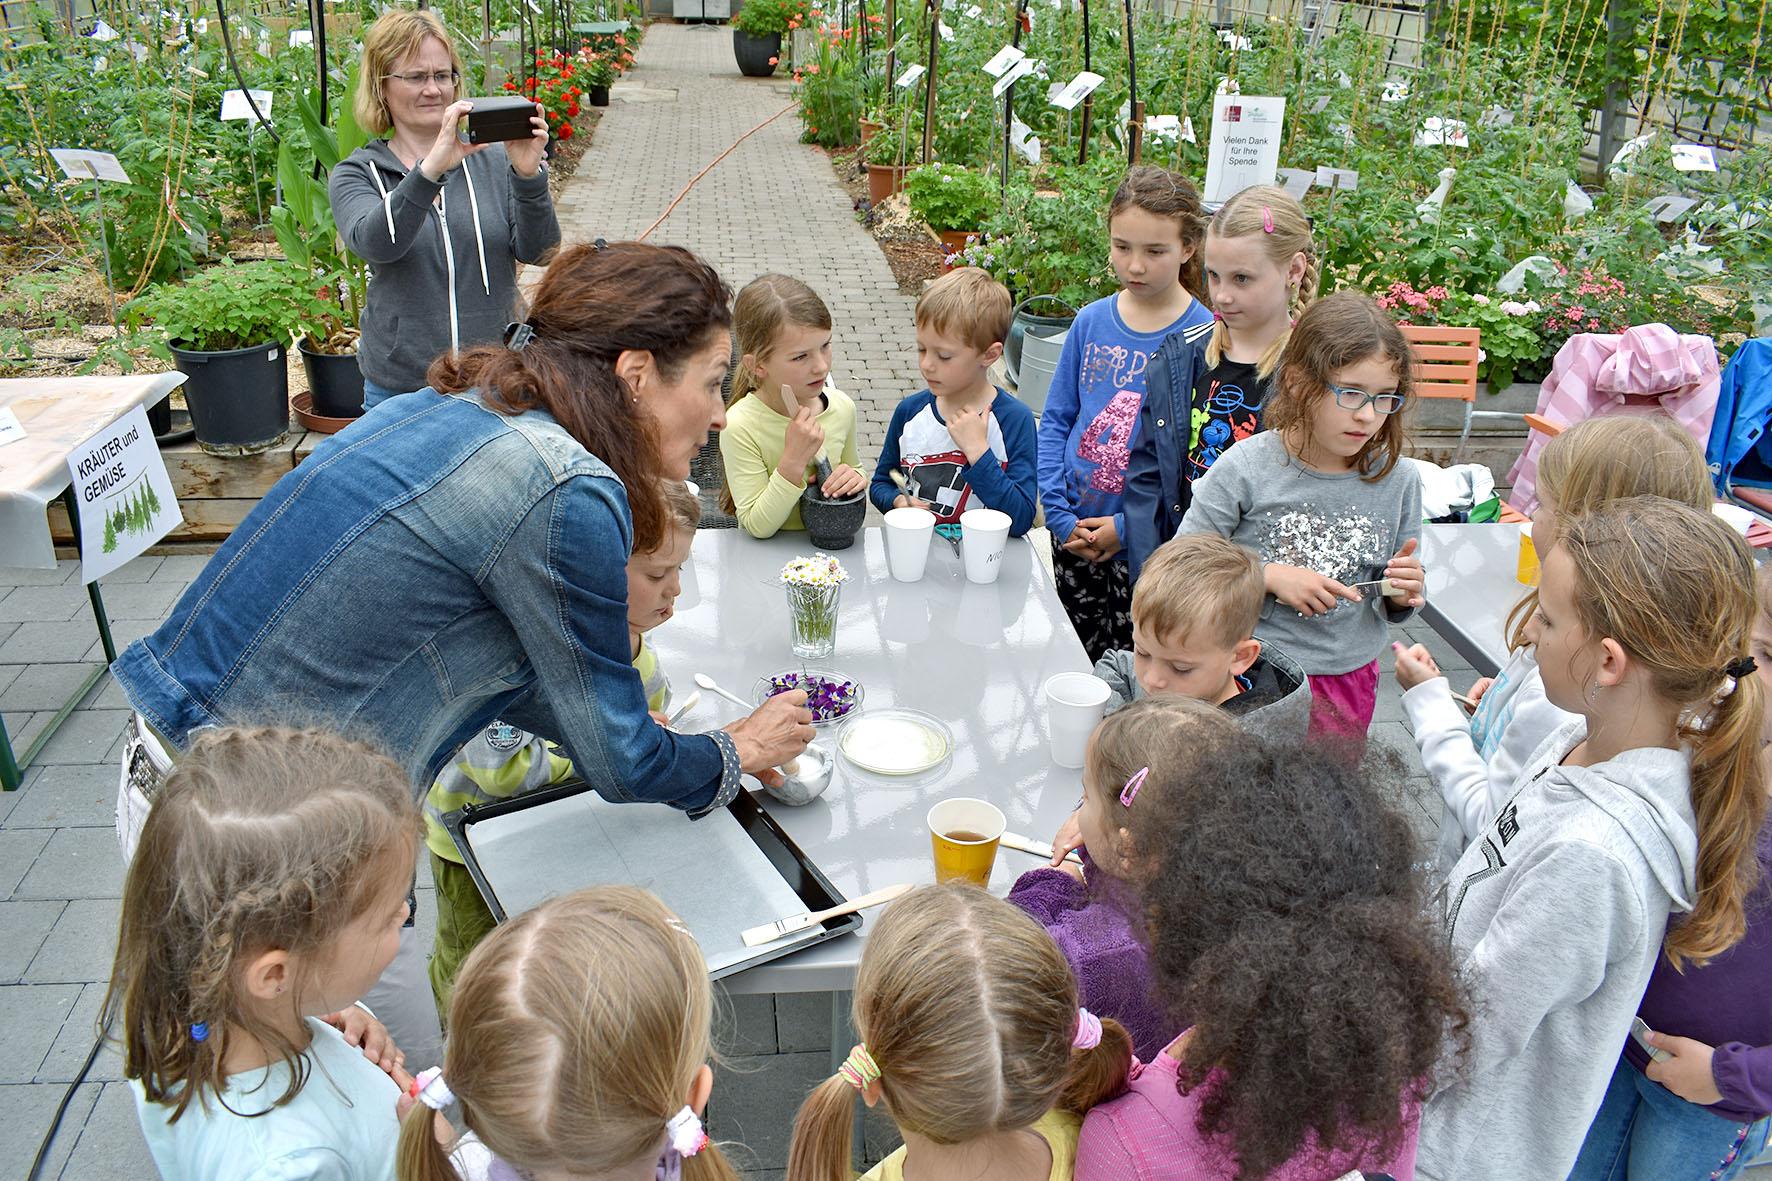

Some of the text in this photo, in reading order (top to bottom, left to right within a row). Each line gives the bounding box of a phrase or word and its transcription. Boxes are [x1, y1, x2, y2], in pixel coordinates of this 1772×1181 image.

[1223, 135, 1269, 145] Vielen Dank
[1231, 146, 1258, 155] für Ihre
[1228, 156, 1258, 167] Spende
[77, 424, 139, 480] KRÄUTER und
[1077, 389, 1142, 496] 4
[84, 461, 127, 502] GEMÜSE
